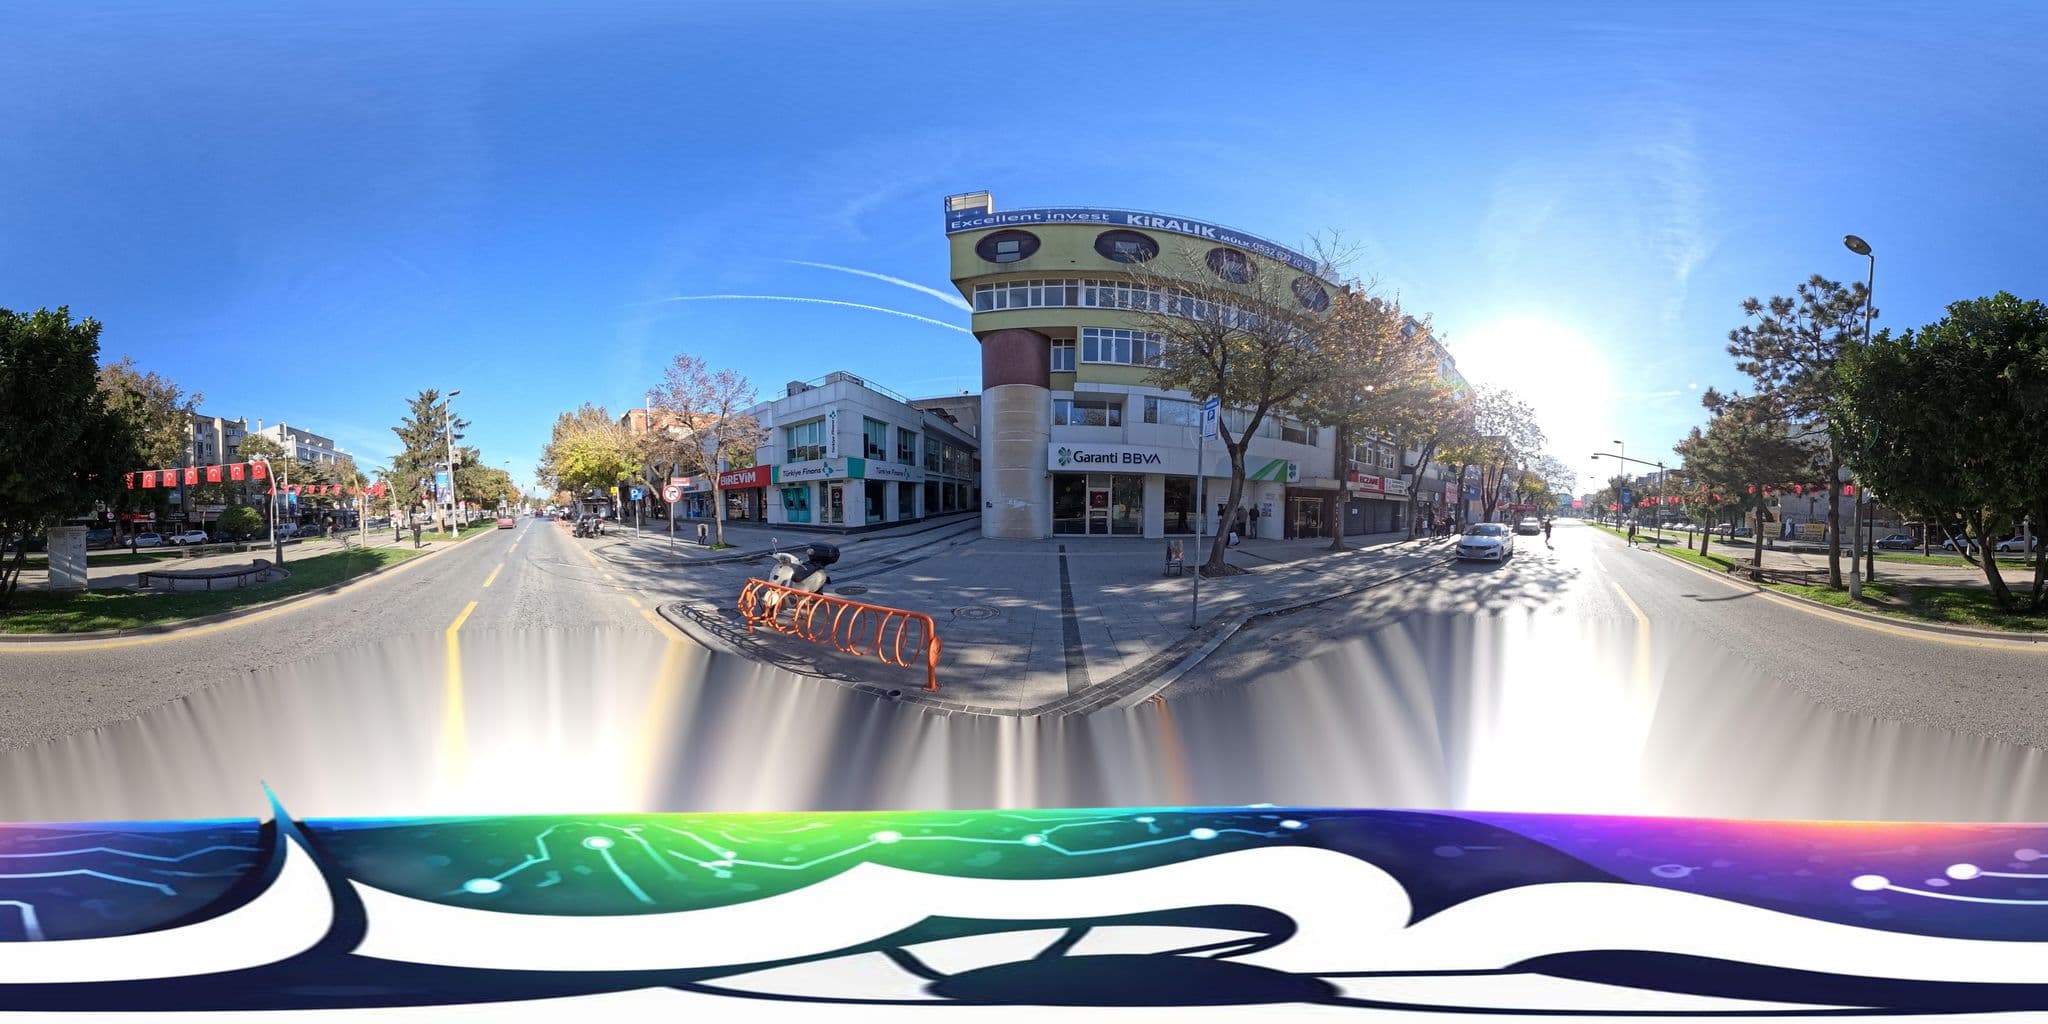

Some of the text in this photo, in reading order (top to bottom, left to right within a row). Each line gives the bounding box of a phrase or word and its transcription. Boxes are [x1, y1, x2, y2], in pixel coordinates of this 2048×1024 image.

[951, 210, 1110, 229] Excellent invest
[1073, 450, 1161, 464] Garanti BBVA
[783, 467, 821, 477] Türkiye Finans
